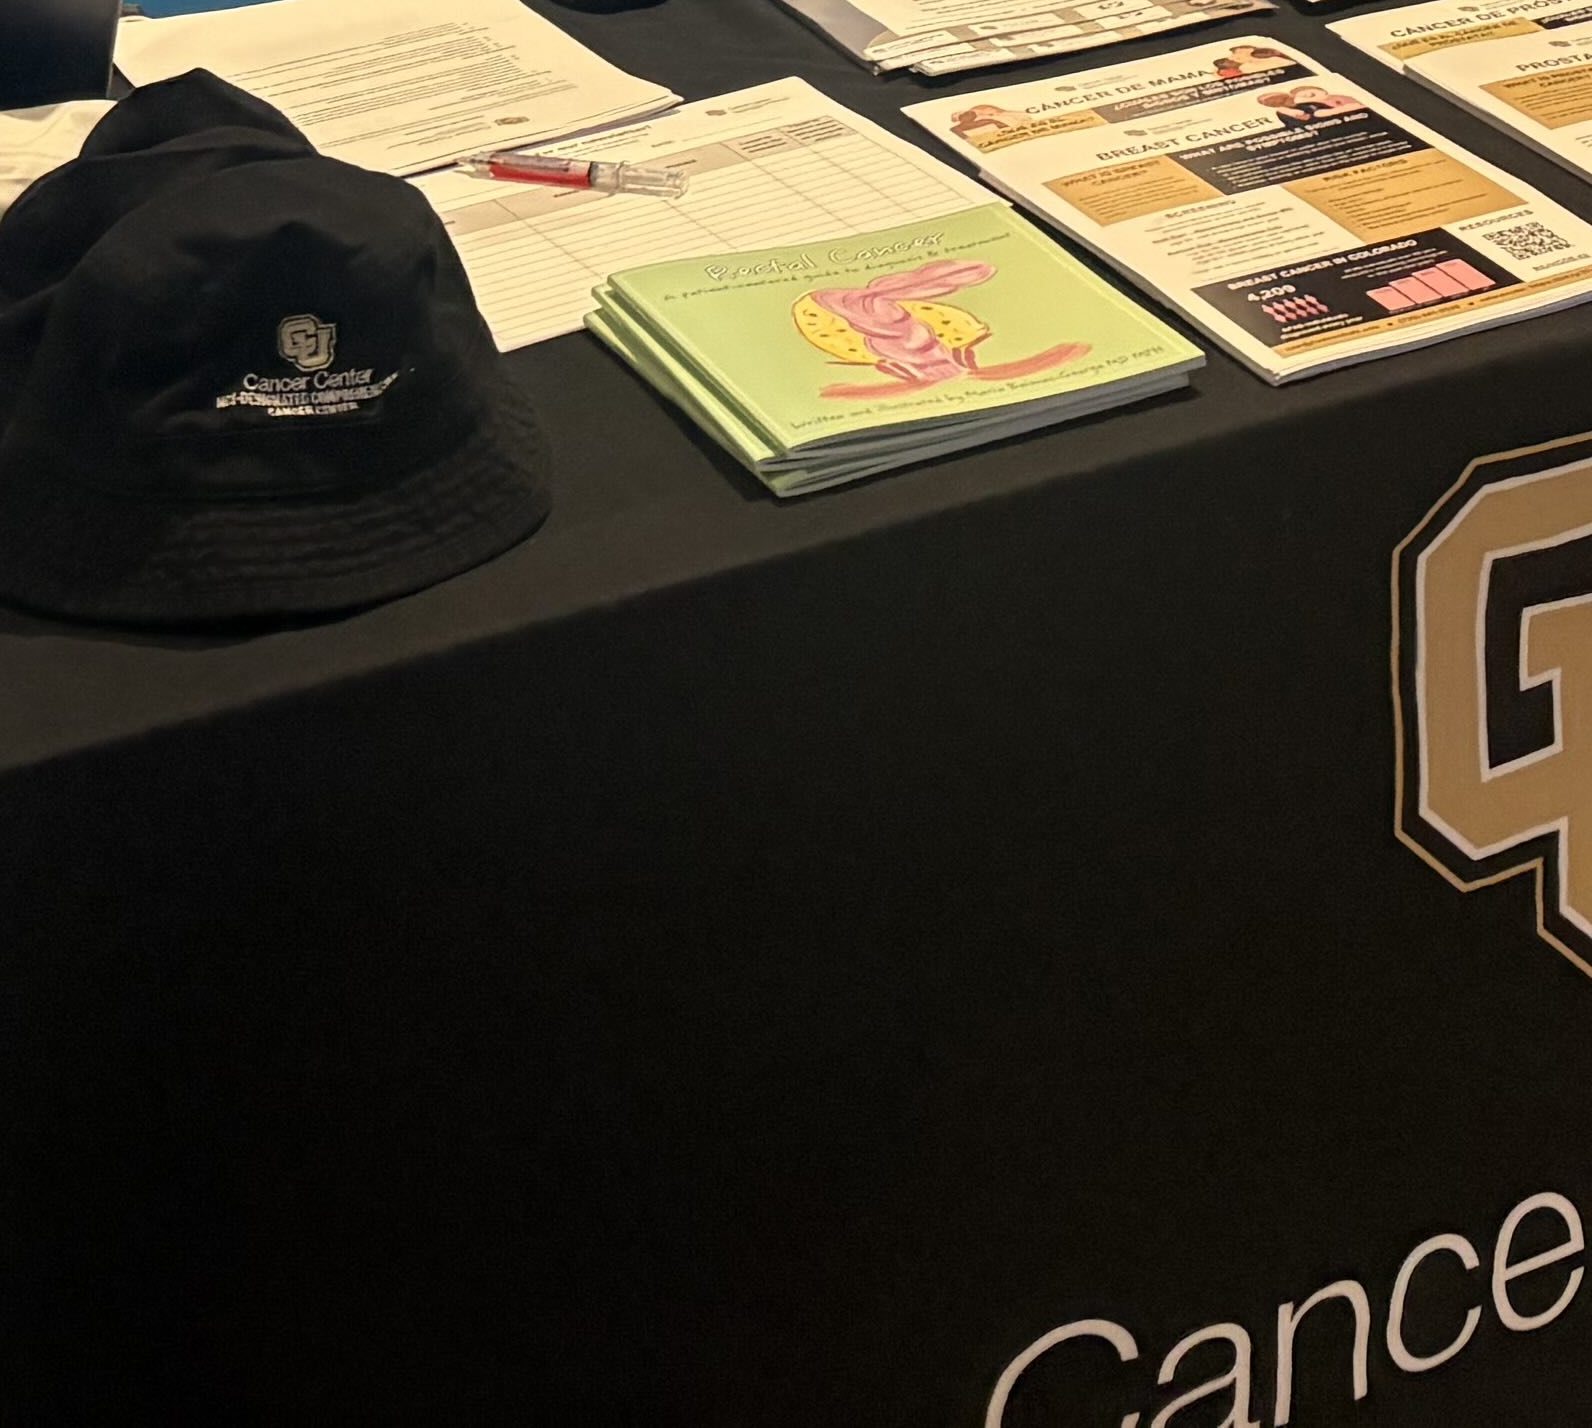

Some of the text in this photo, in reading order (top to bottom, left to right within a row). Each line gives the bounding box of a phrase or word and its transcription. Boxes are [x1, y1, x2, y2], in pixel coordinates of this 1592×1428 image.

[1150, 69, 1216, 89] MAMA
[1096, 115, 1275, 162] BREAST CANCER
[828, 231, 944, 265] Cancer
[1227, 271, 1277, 291] BREAST
[278, 313, 338, 373] CU
[243, 368, 376, 393] Cancer Center
